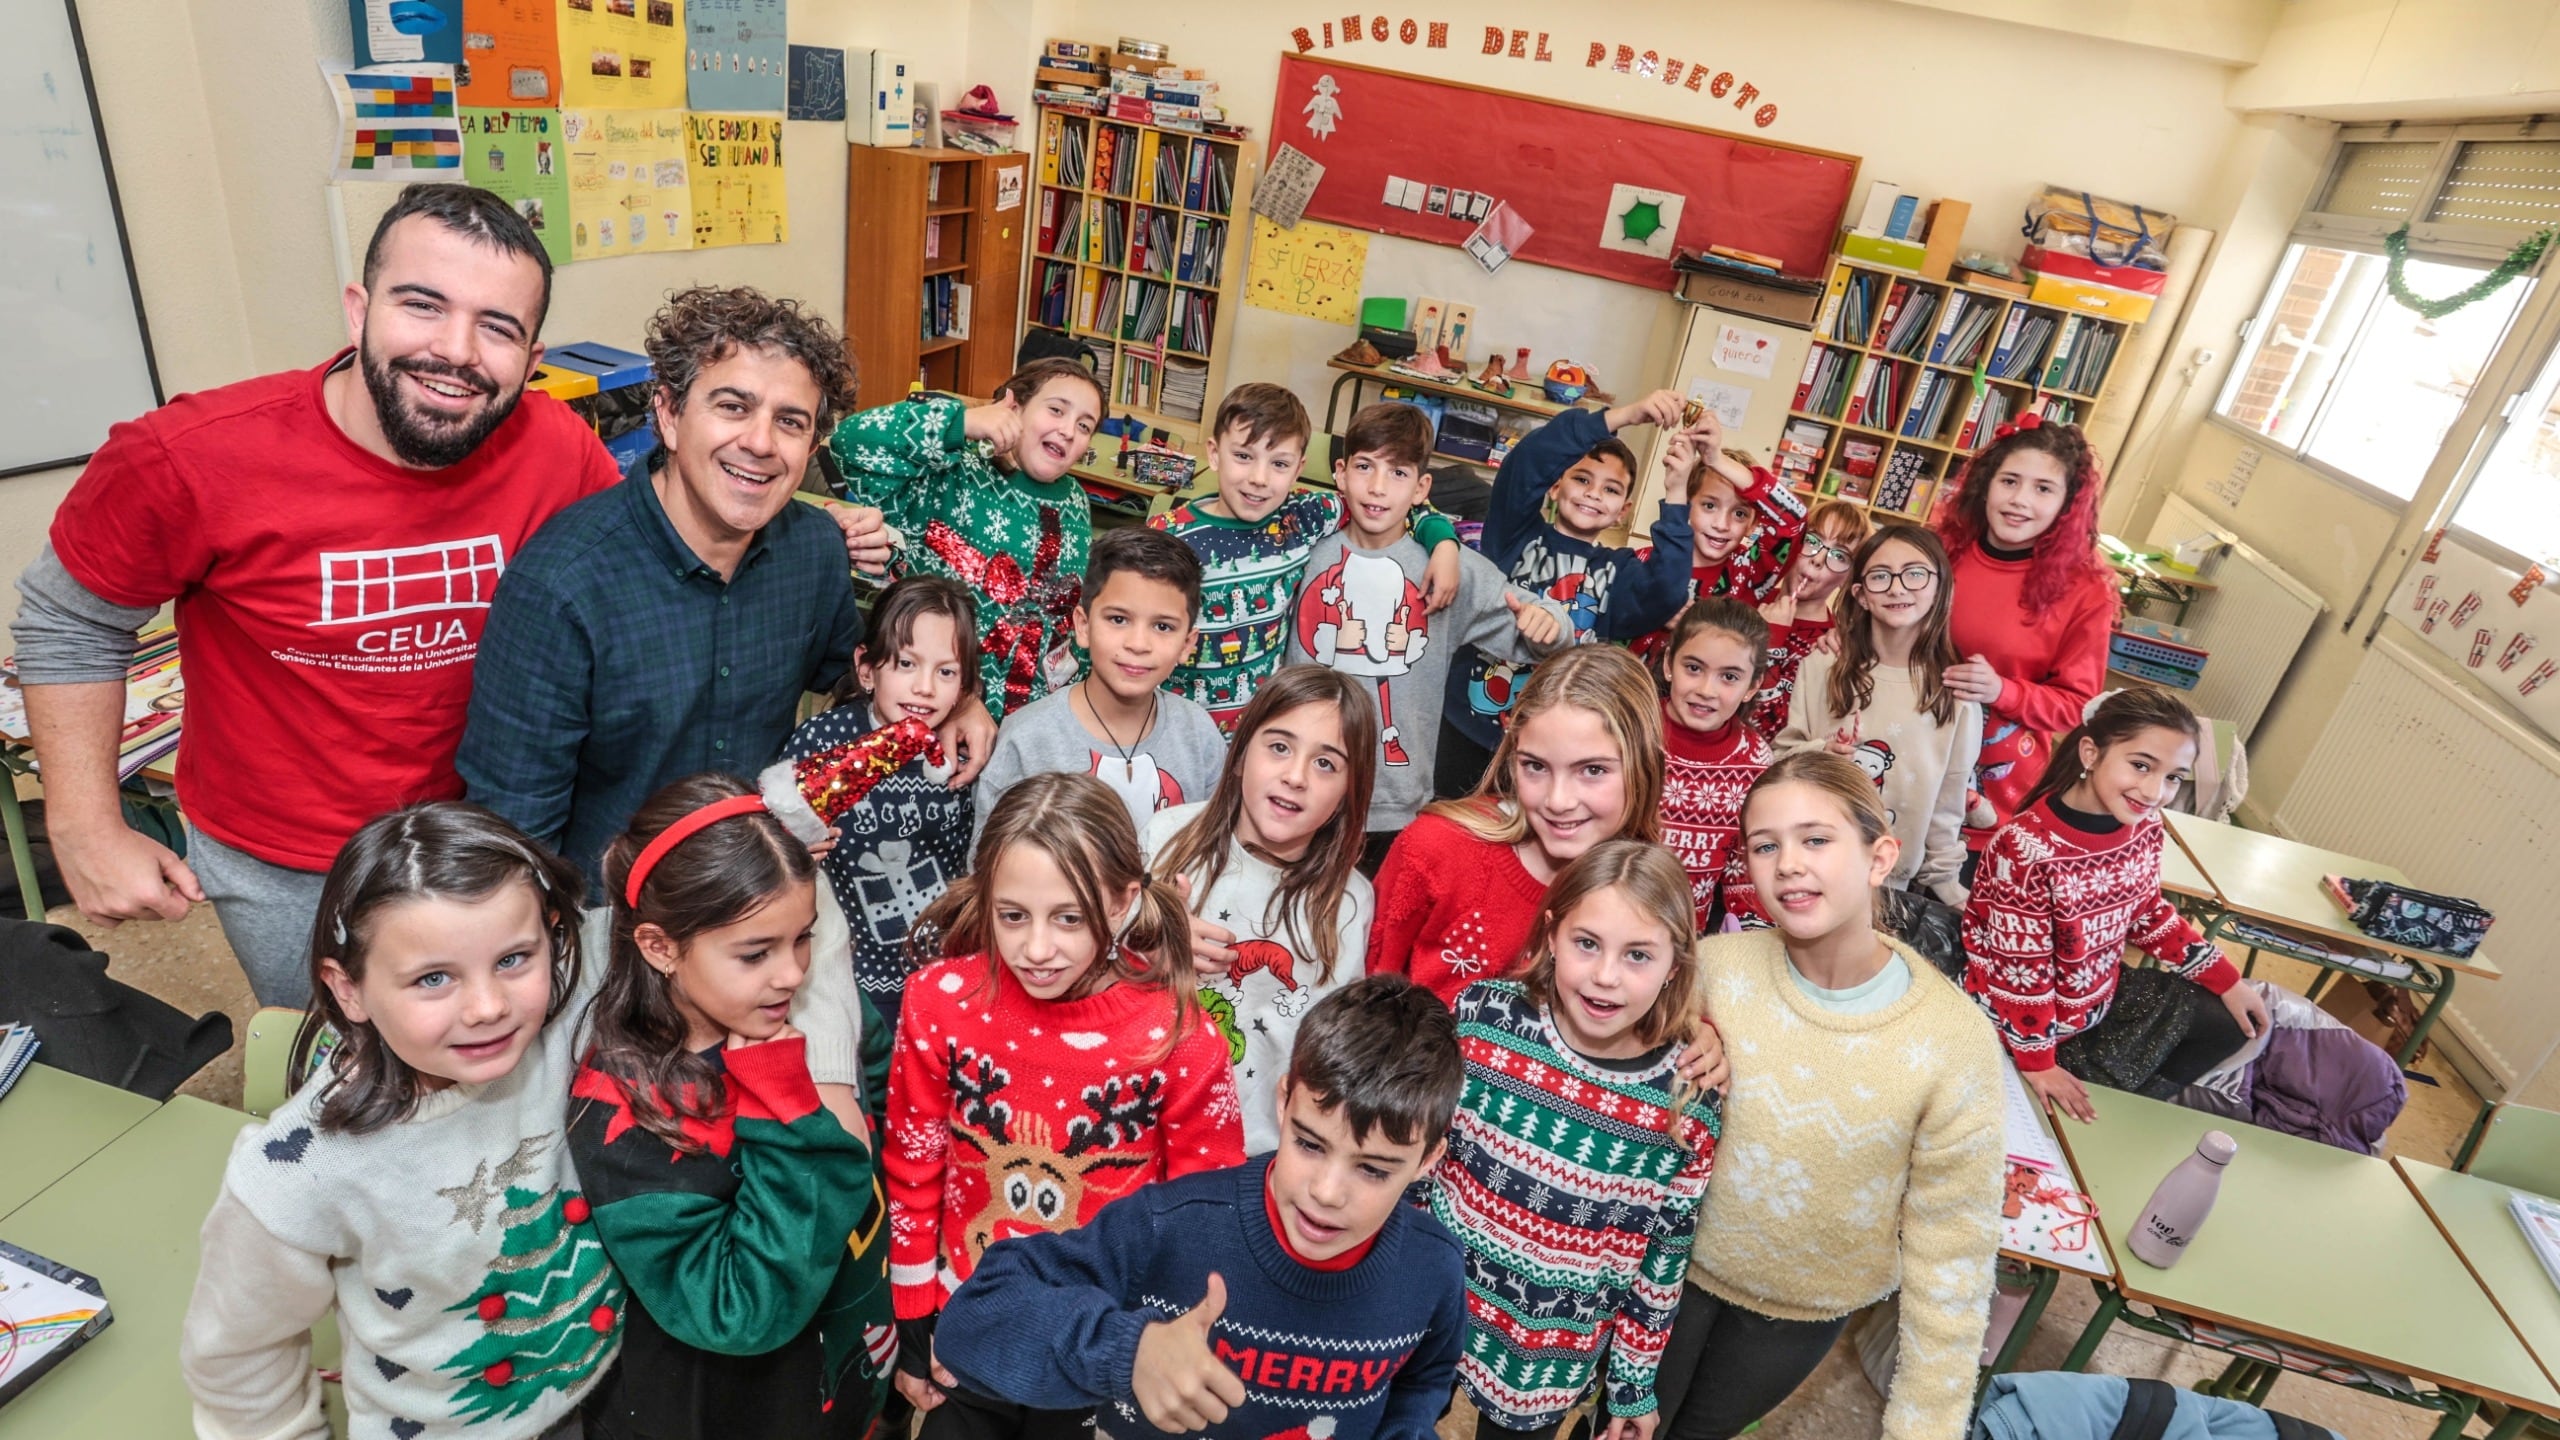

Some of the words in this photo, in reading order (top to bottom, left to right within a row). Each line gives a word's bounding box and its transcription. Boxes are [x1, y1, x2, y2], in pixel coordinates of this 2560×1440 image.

[1291, 15, 1449, 54] RINCON
[1482, 26, 1552, 62] DEL
[1586, 41, 1778, 128] PROYECTO
[484, 115, 506, 134] DEL
[696, 118, 715, 141] LAS
[718, 119, 749, 142] EDADES
[700, 144, 722, 167] SER
[727, 146, 769, 167] HUMANO
[1708, 285, 1740, 300] GOMA
[1722, 347, 1761, 363] quiero
[357, 619, 468, 653] CEUA
[270, 650, 316, 667] Consejo
[318, 660, 332, 668] de
[334, 661, 398, 673] Estudiantes
[399, 663, 411, 672] de
[413, 663, 422, 671] la
[400, 653, 412, 662] de
[415, 652, 423, 660] la
[425, 642, 477, 658] Universitat
[1661, 828, 1725, 850] ERRY
[2084, 921, 2128, 950] XMA
[1481, 1219, 1518, 1250] Merry
[1522, 1242, 1582, 1267] Christmas
[1216, 1338, 1390, 1393] MERRY
